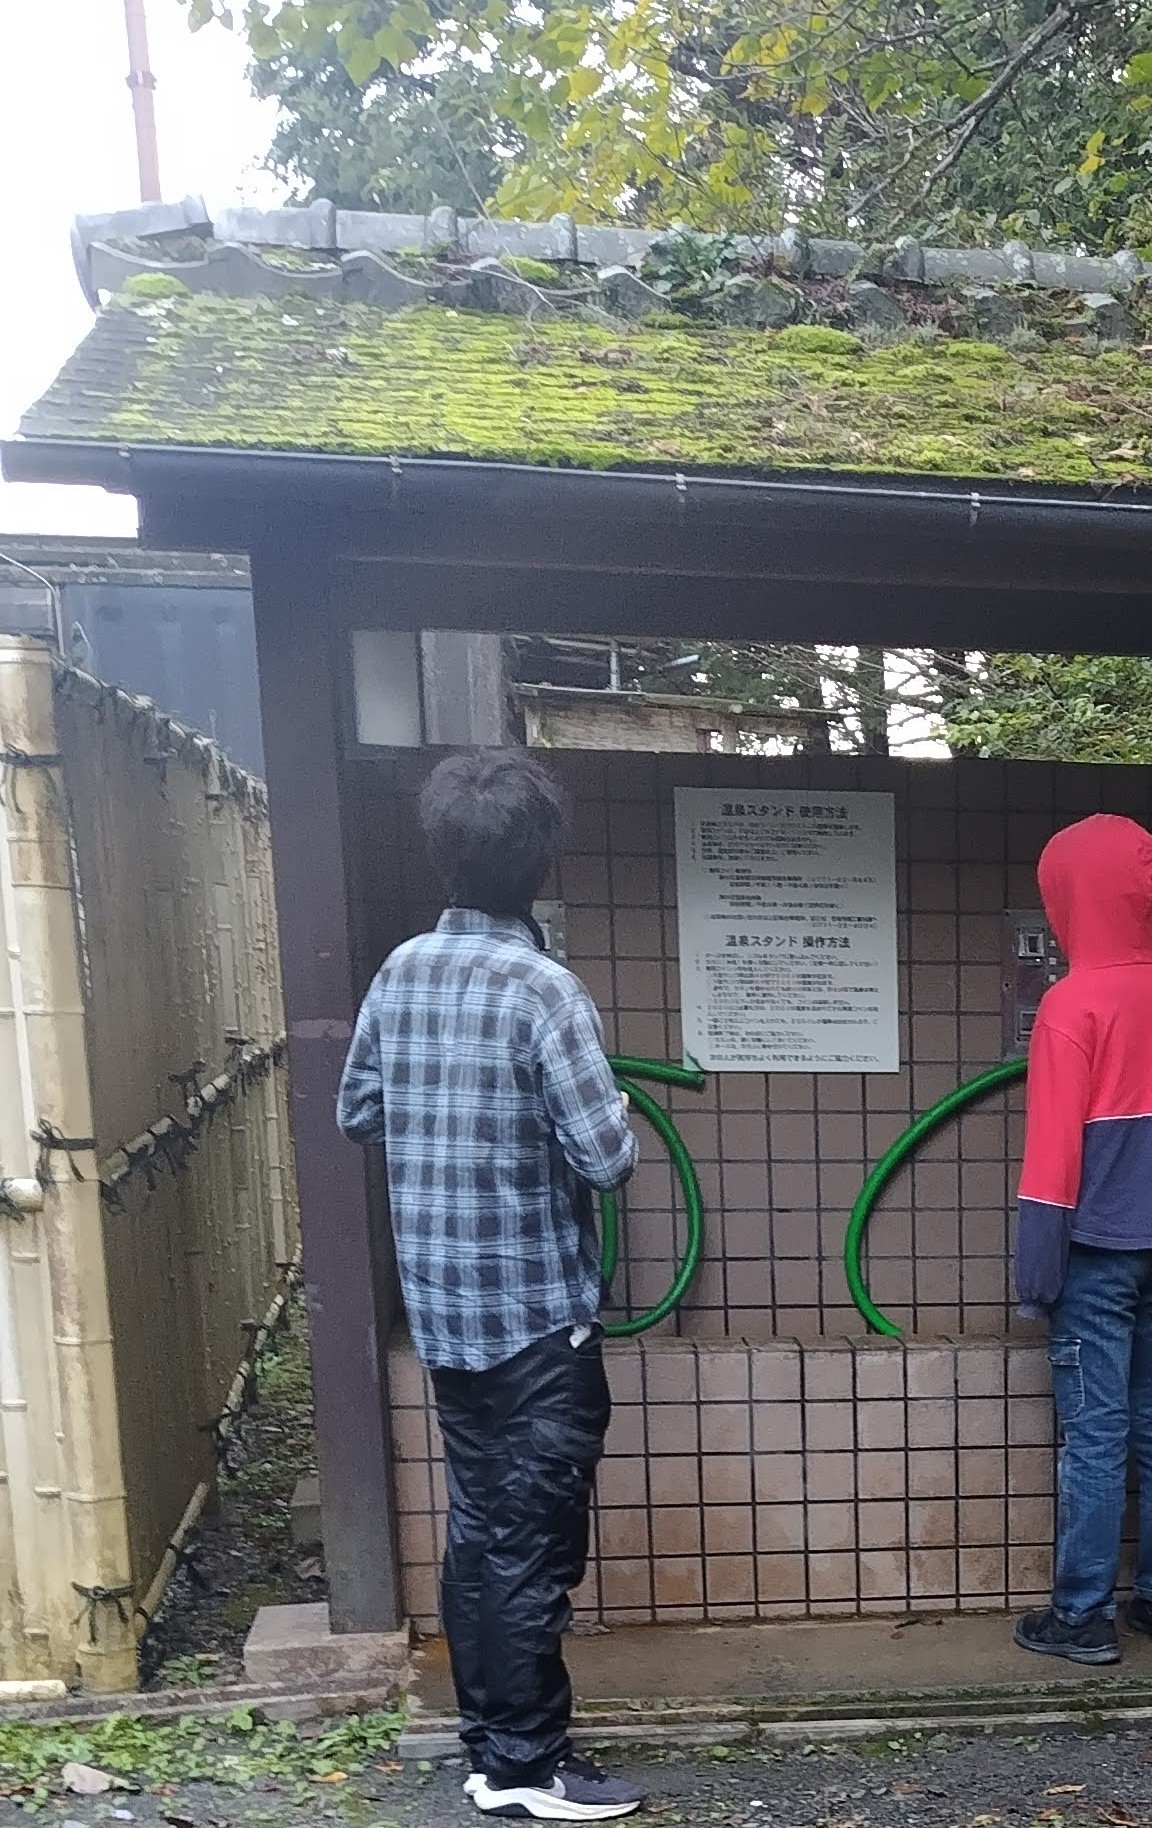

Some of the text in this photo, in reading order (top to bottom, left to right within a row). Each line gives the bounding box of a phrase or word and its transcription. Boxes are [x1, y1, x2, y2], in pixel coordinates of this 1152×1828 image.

[721, 803, 795, 817] 温泉スタンド
[725, 934, 851, 948] 温泉スタンド 操作方法
